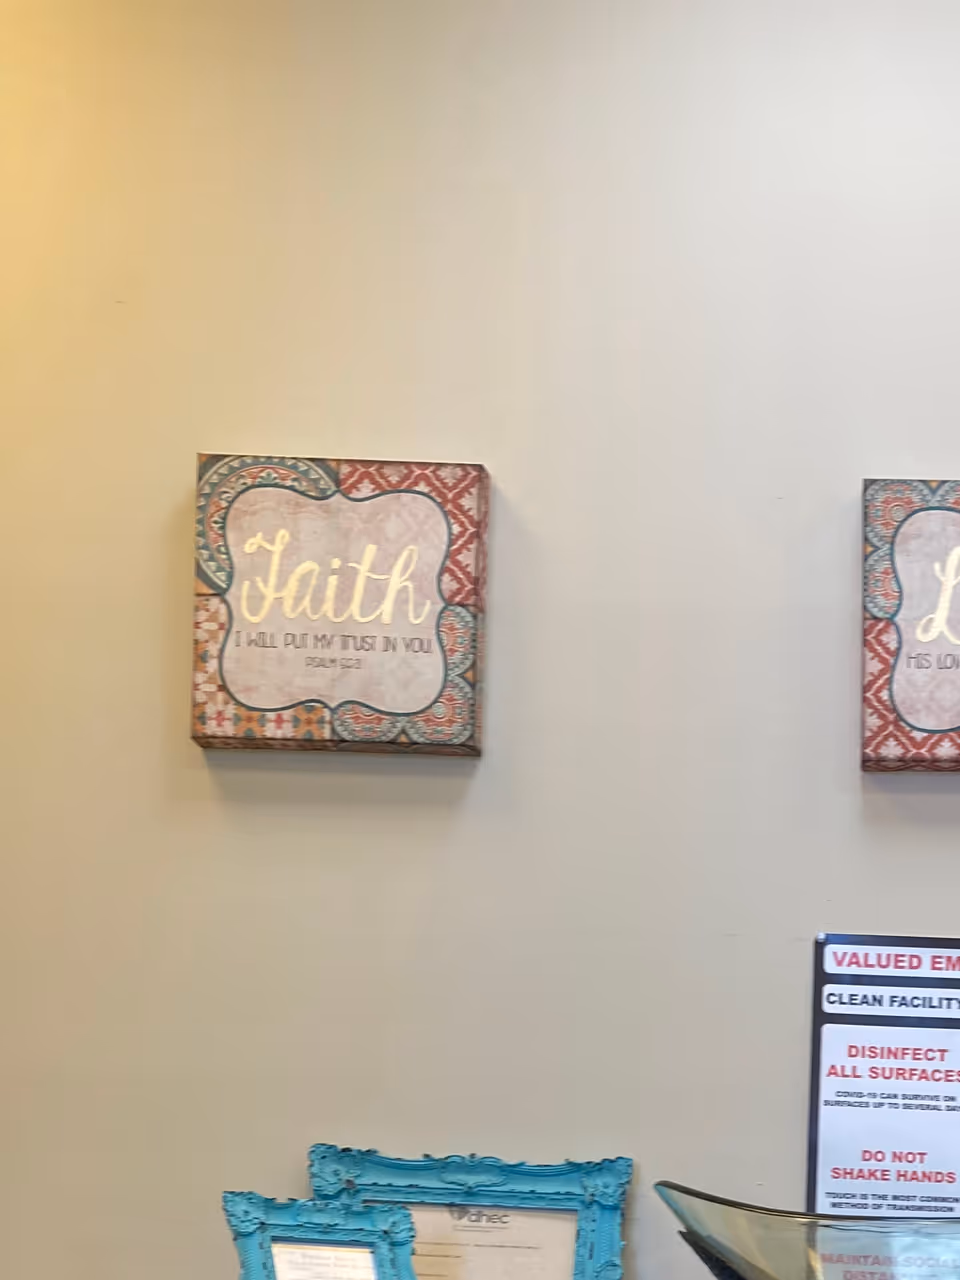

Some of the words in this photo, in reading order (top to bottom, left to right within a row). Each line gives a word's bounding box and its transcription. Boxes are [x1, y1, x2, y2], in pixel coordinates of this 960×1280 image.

[240, 528, 432, 625] Faith
[235, 631, 242, 647] I
[246, 631, 278, 649] WILL
[284, 632, 309, 650] PUT
[312, 633, 335, 649] MY
[339, 634, 377, 651] TRUST
[382, 636, 397, 652] IN
[305, 656, 337, 668] PSALM
[906, 653, 932, 669] HIS
[832, 951, 922, 970] VALUED
[825, 992, 884, 1007] CLEAN
[847, 1044, 949, 1062] DISINFECT
[826, 1064, 863, 1079] ALL
[879, 1092, 899, 1100] CAN
[901, 1093, 941, 1101] SURVIVE
[823, 1100, 870, 1108] SURFACES
[872, 1101, 885, 1109] UP
[901, 1103, 943, 1111] SEVERAL
[861, 1149, 885, 1163] DO
[892, 1151, 927, 1165] NOT
[830, 1167, 891, 1181] SHAKE
[896, 1169, 957, 1184] HANDS
[825, 1191, 857, 1200] TOUCH
[870, 1193, 889, 1201] THE
[891, 1194, 917, 1202] MOST
[919, 1195, 960, 1203] COMMON
[830, 1201, 869, 1209] METHOD
[871, 1202, 883, 1210] OF
[886, 1203, 954, 1212] TRANSMISSION
[467, 1210, 511, 1224] dhec
